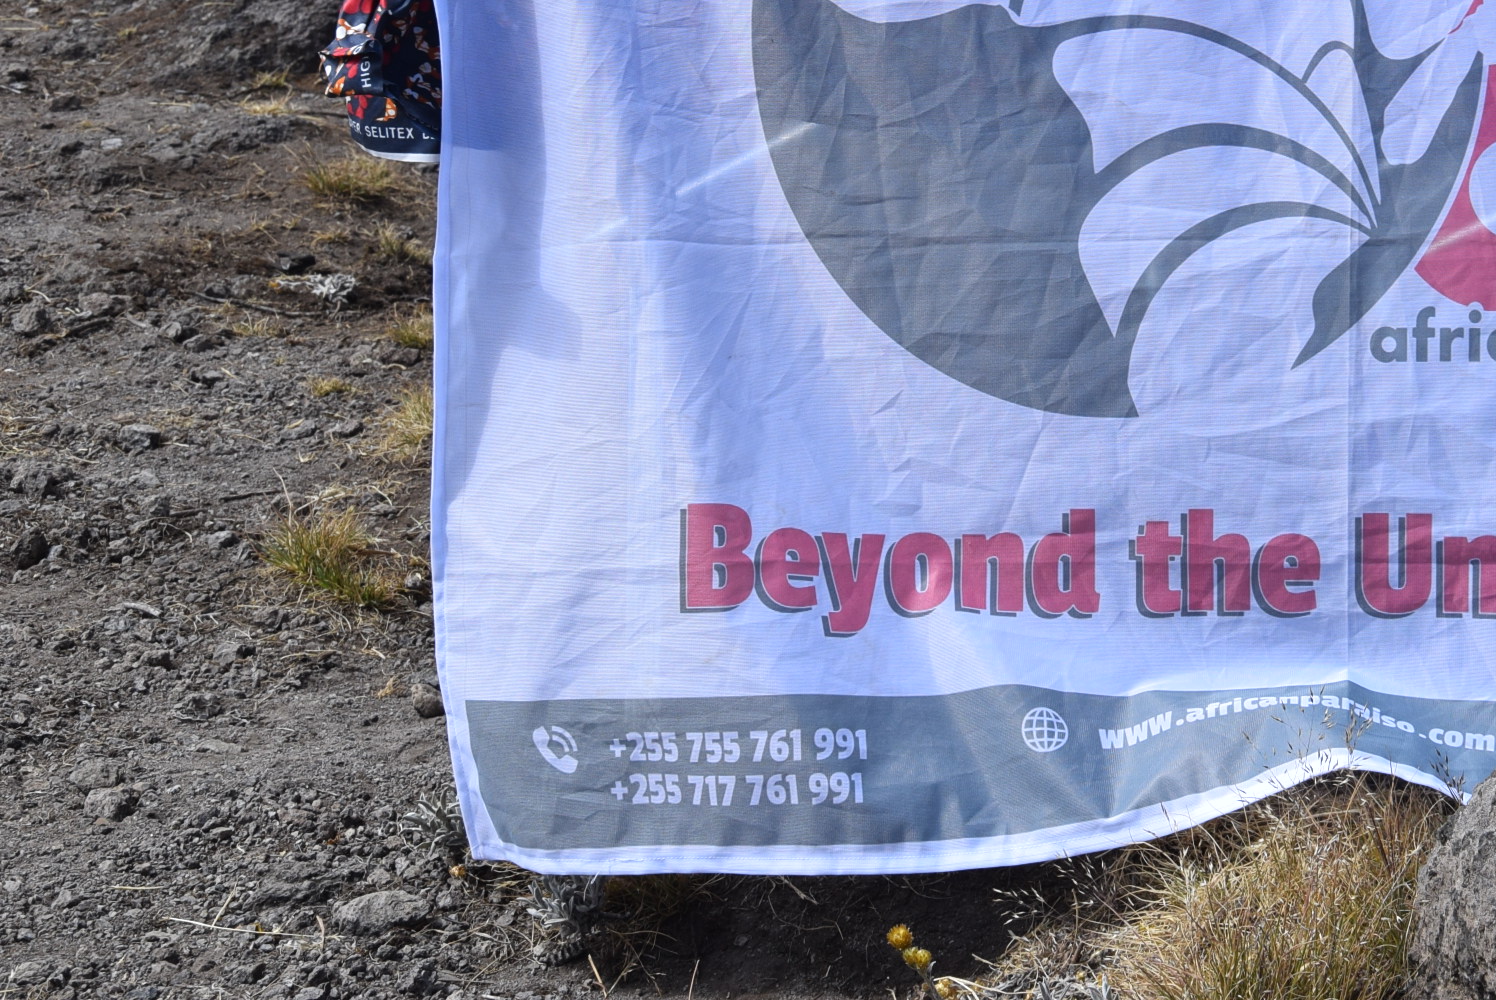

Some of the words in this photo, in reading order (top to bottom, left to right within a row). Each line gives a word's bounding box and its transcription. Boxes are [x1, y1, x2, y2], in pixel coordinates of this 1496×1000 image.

[360, 56, 372, 88] HIG
[364, 125, 415, 139] SELITEX
[679, 503, 1101, 638] Beyond
[1128, 508, 1321, 619] the
[1098, 695, 1496, 752] www.africanparaiso.com
[609, 732, 679, 763] +255
[686, 732, 741, 763] 755
[749, 728, 803, 761] 761
[814, 727, 868, 760] 991
[611, 773, 683, 806] +255
[687, 775, 736, 806] 717
[745, 774, 799, 806] 761
[808, 772, 864, 804] 991
